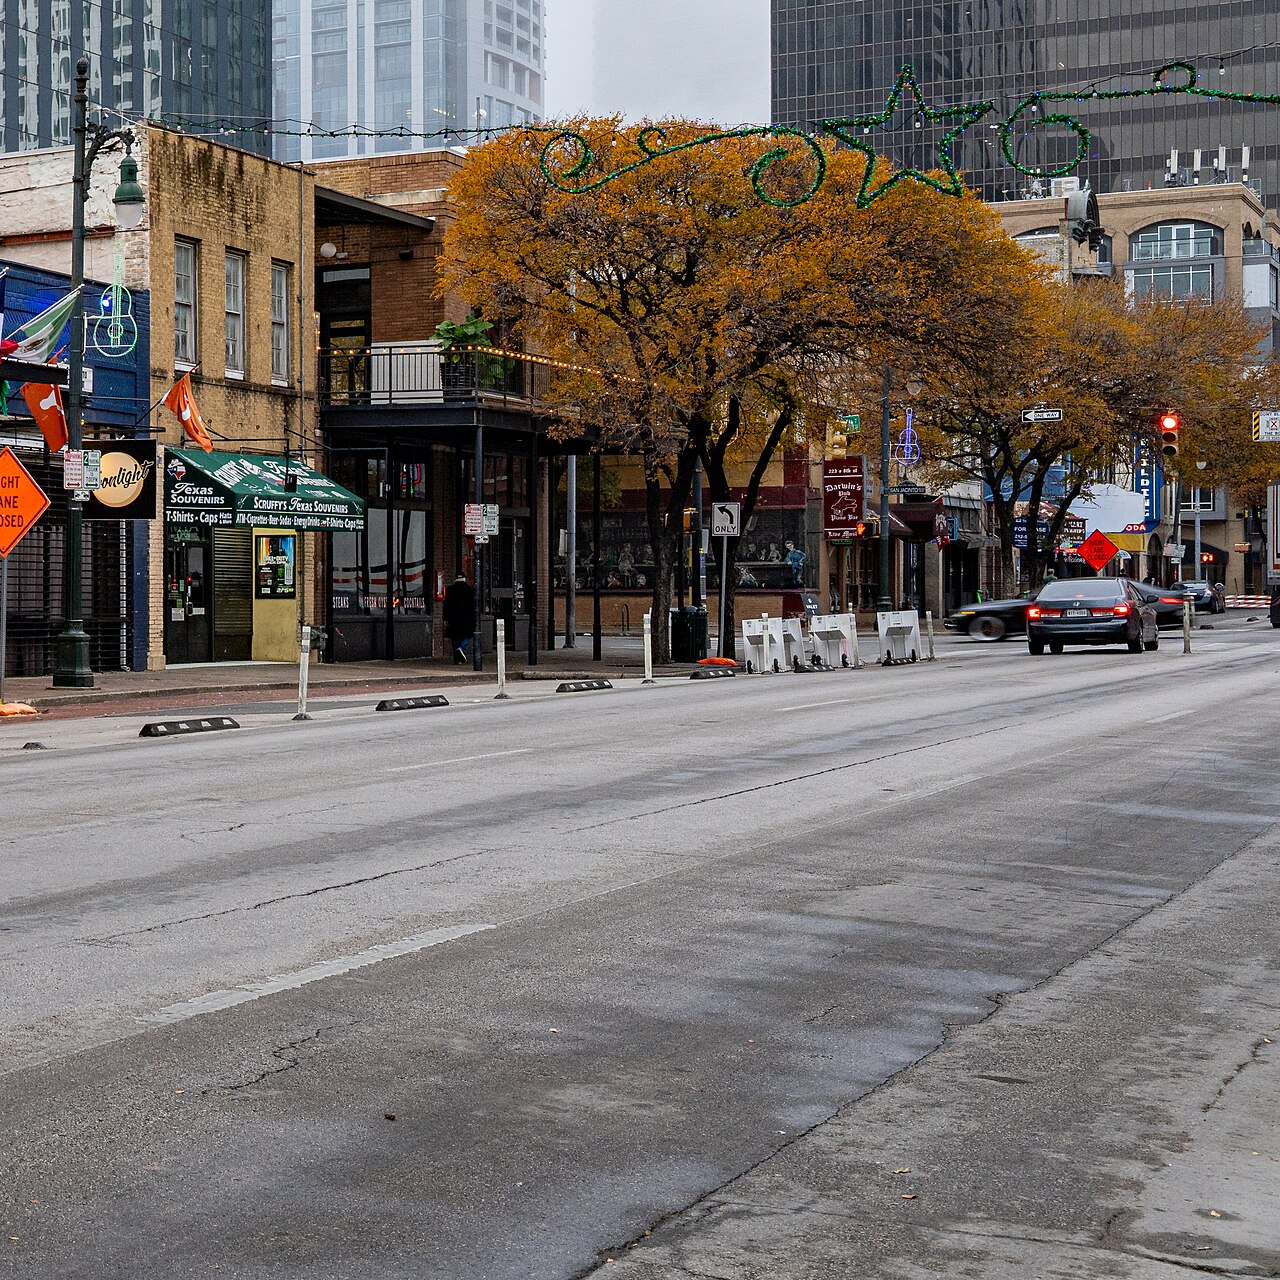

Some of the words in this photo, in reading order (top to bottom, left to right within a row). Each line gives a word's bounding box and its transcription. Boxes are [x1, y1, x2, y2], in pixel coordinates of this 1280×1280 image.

[100, 460, 154, 488] onlight
[171, 482, 214, 495] Texas
[825, 482, 862, 492] Darwin's
[170, 494, 225, 504] SOUVENIRS
[288, 497, 313, 511] Texas
[199, 511, 218, 526] Caps
[332, 597, 349, 608] STEAKS
